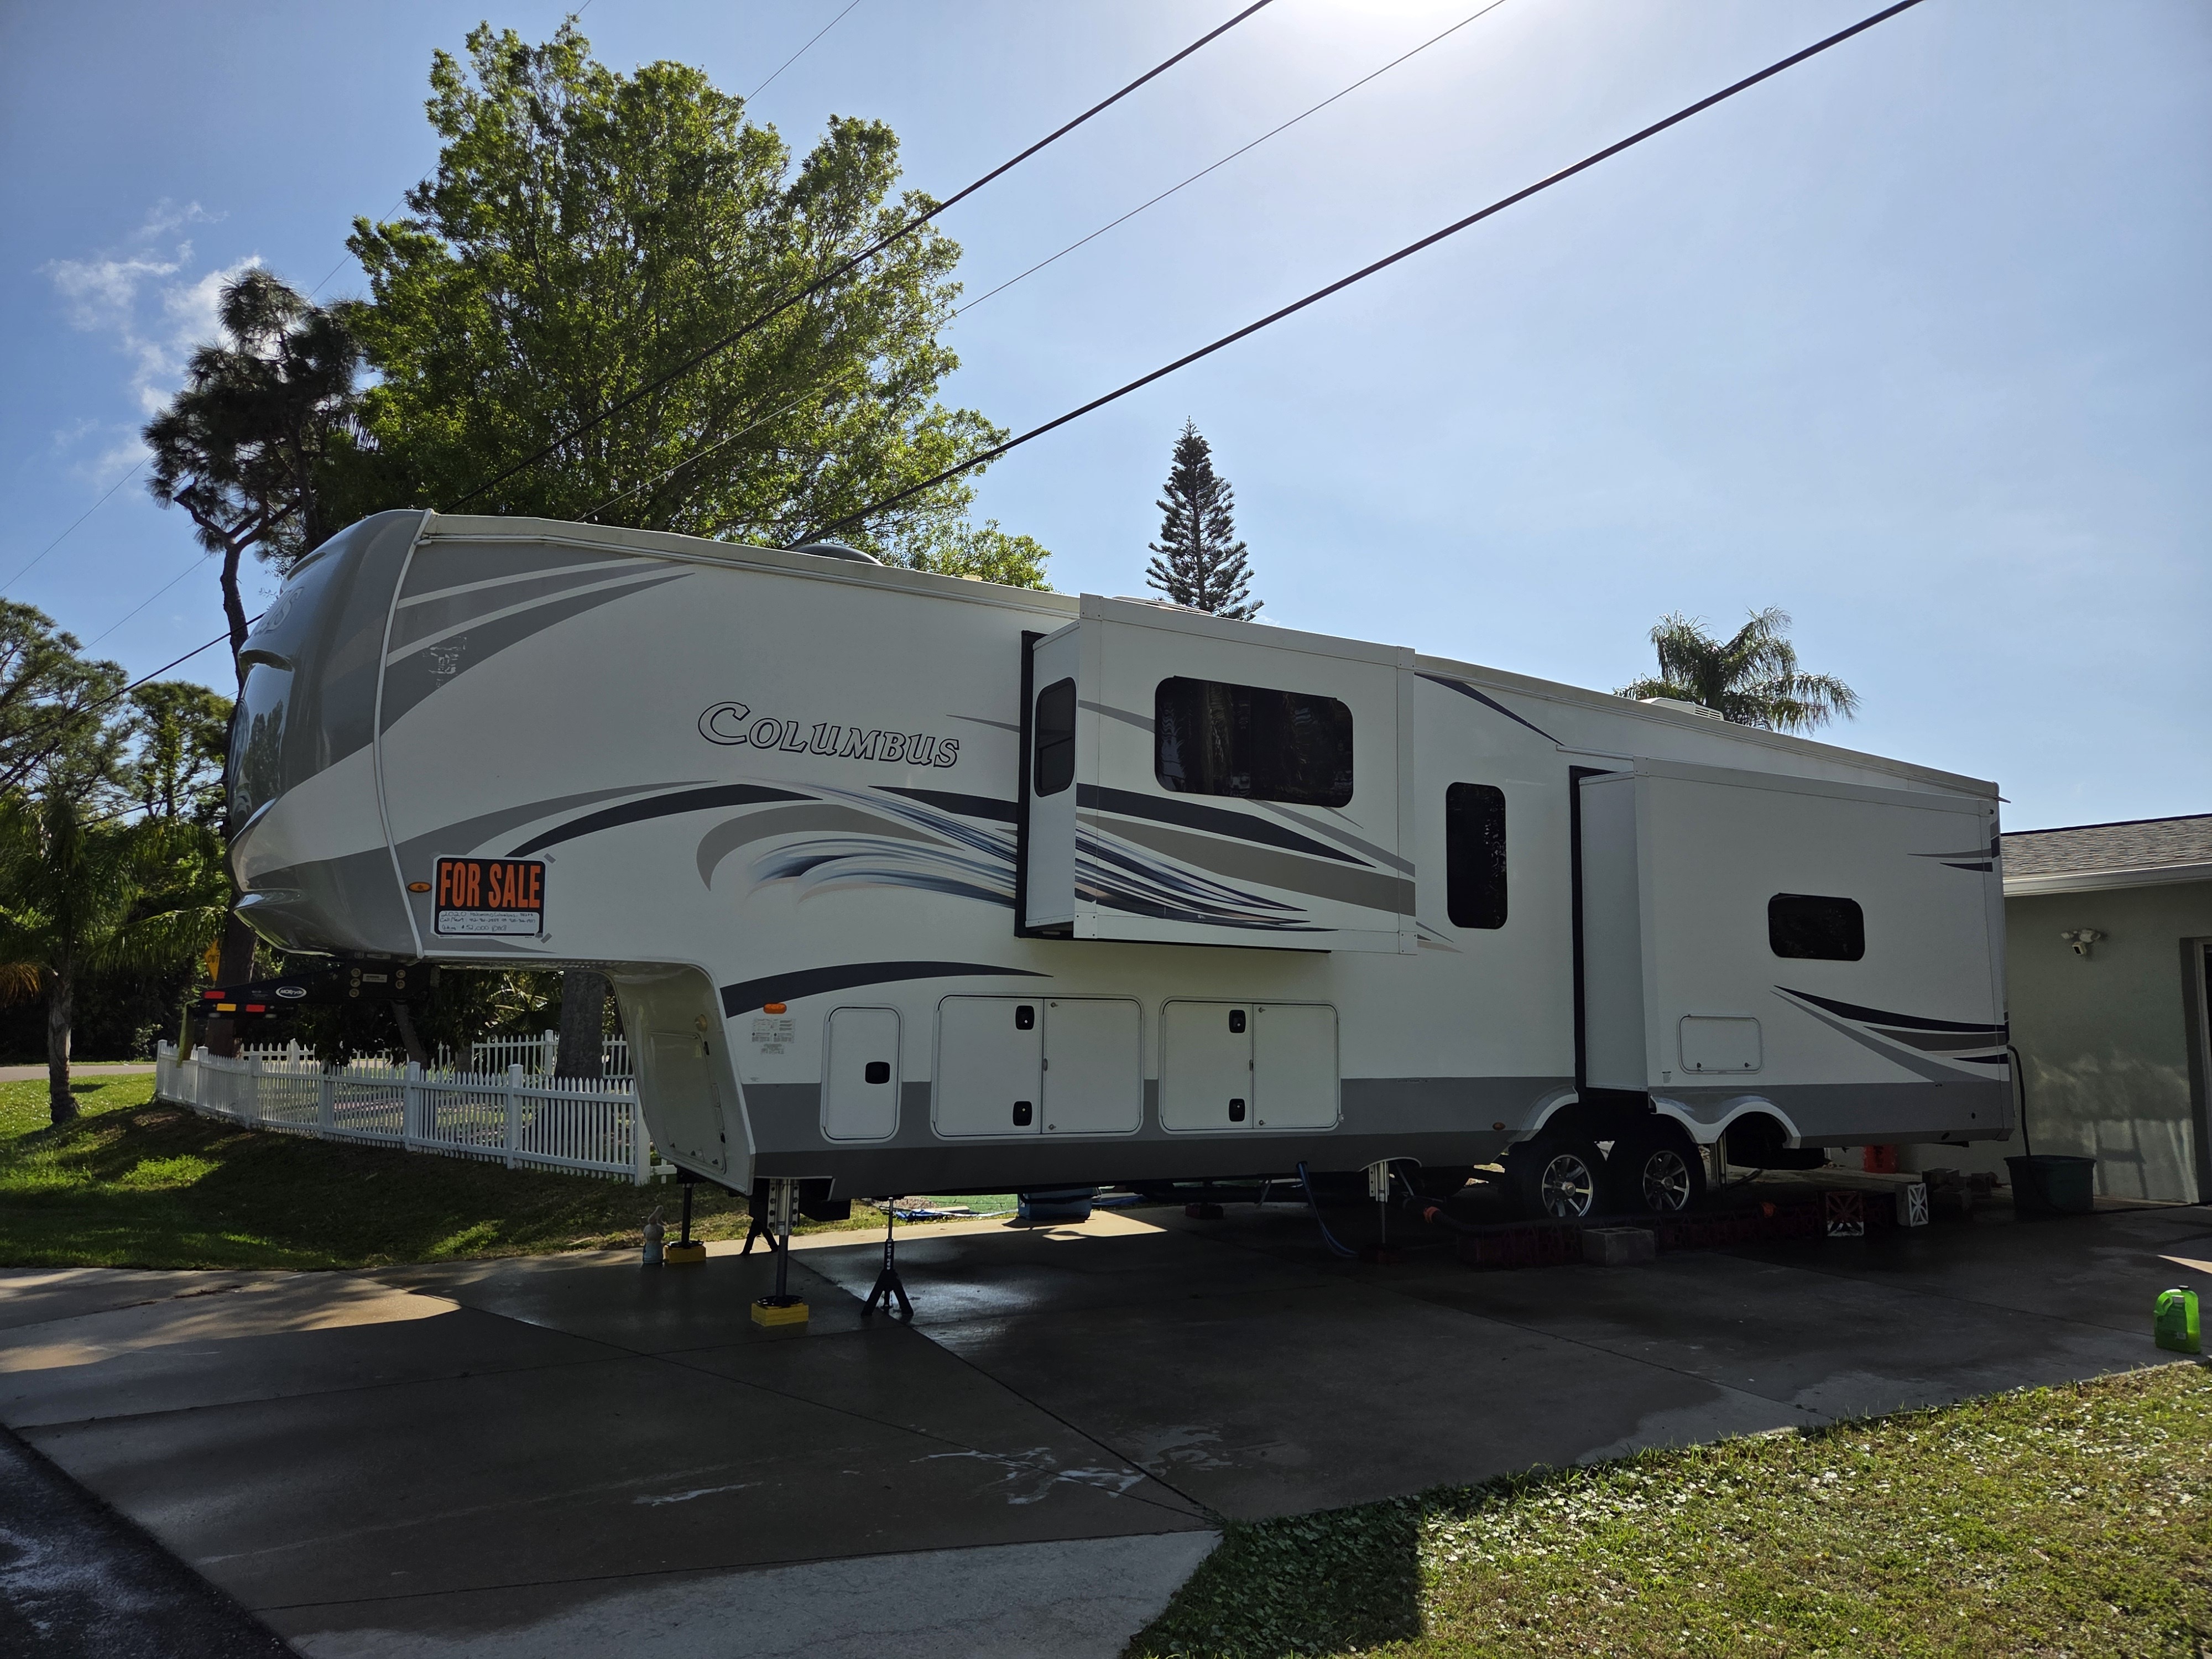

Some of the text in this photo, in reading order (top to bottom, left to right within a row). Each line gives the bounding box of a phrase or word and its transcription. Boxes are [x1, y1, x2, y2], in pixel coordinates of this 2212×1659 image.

[698, 701, 959, 768] COLUMBUS
[440, 862, 541, 907] FOR SALE
